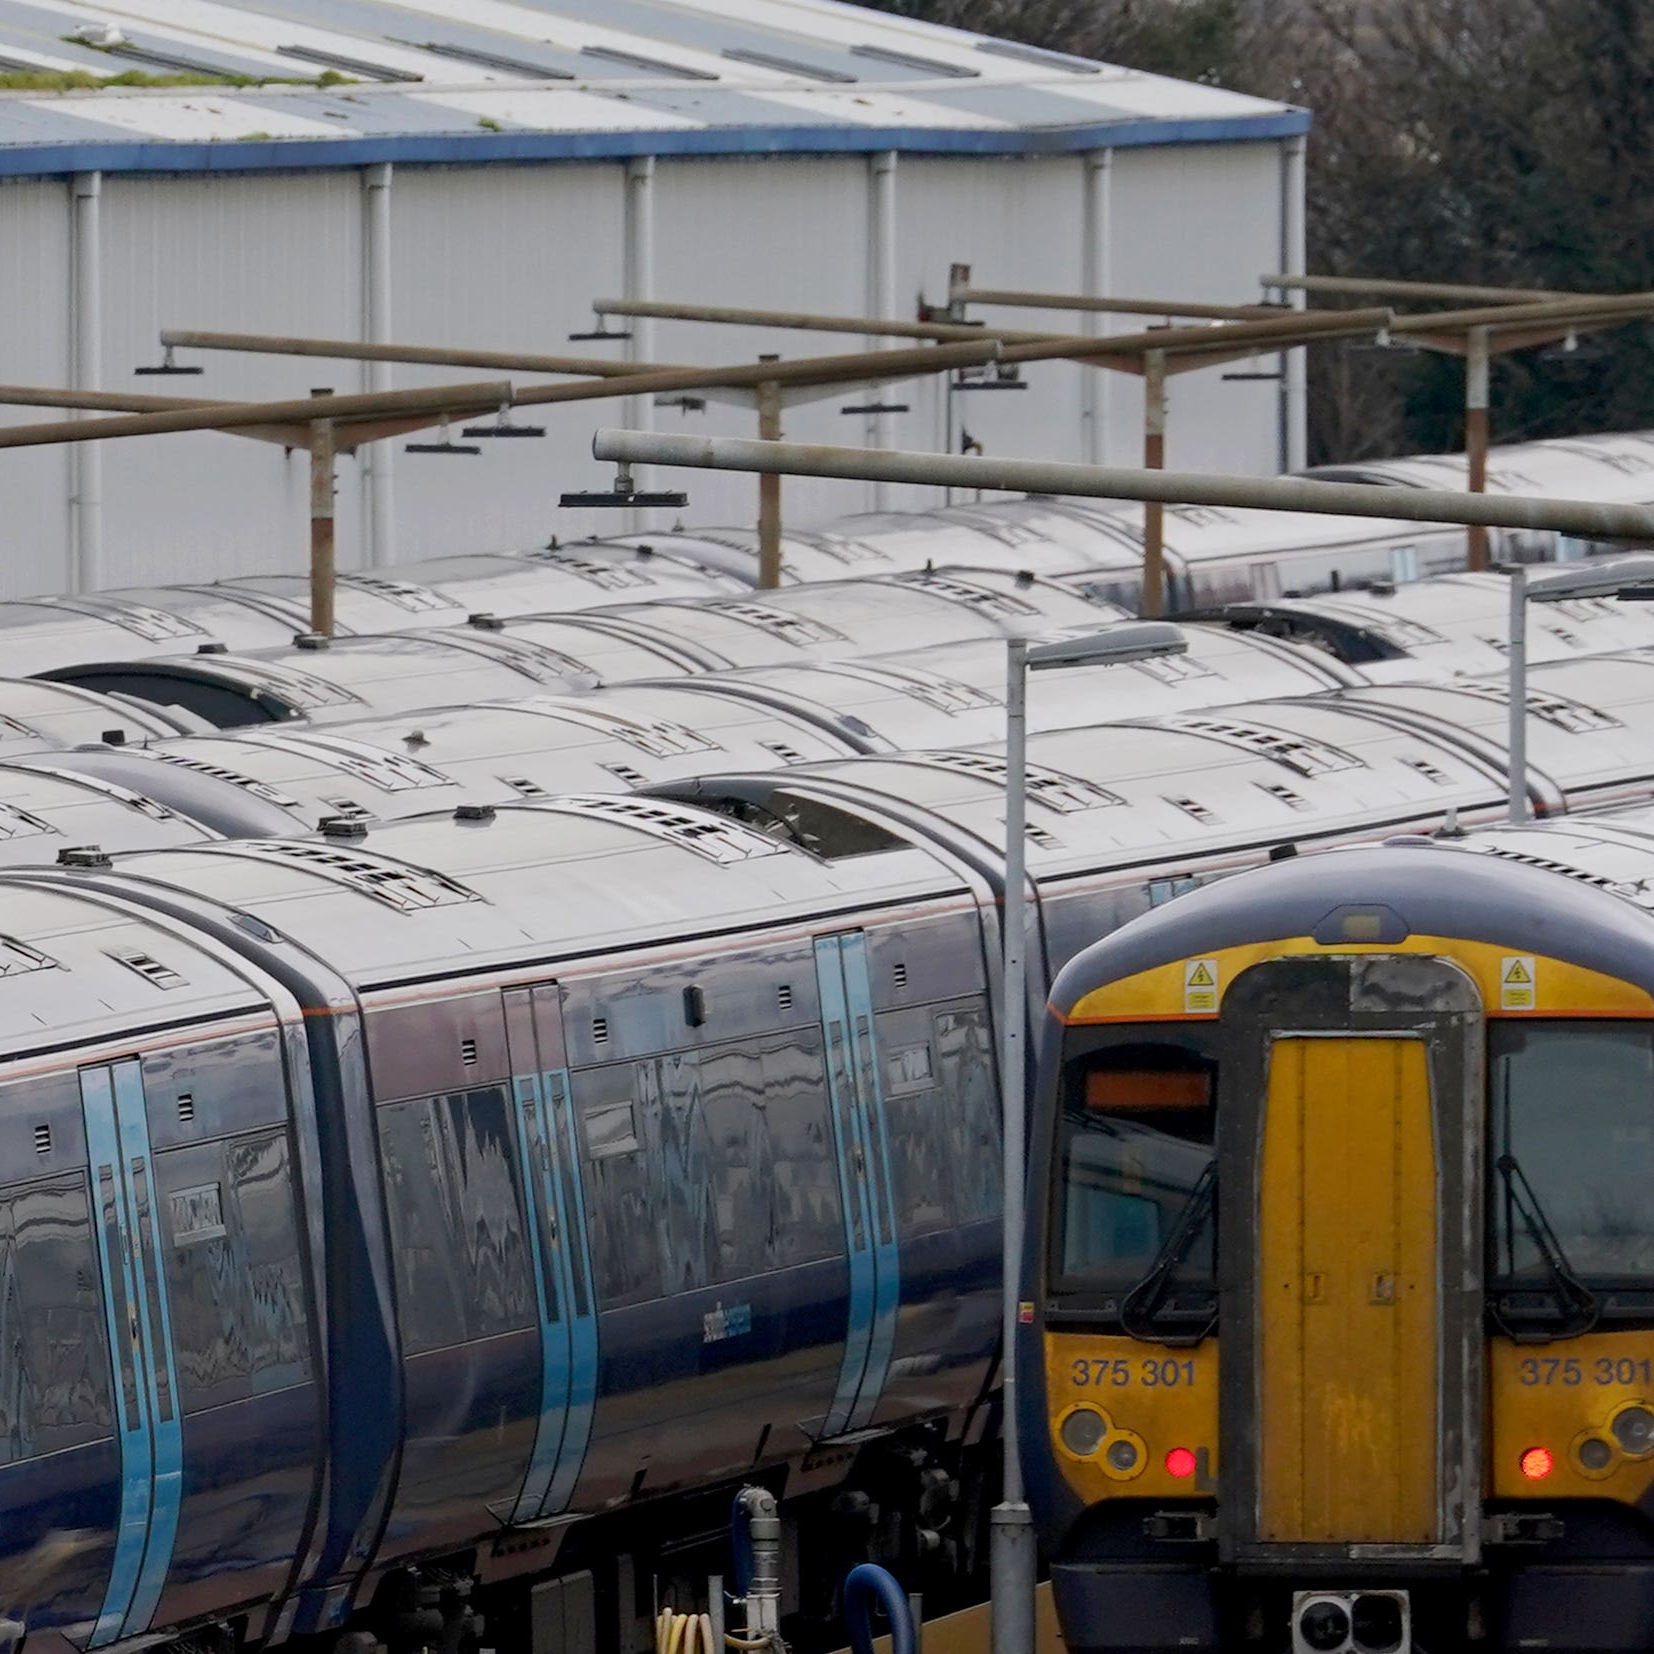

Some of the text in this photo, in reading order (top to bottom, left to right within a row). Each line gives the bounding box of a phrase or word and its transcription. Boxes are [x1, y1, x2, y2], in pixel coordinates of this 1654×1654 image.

[1072, 1359, 1195, 1386] 375 301
[1521, 1357, 1653, 1386] 375 301
